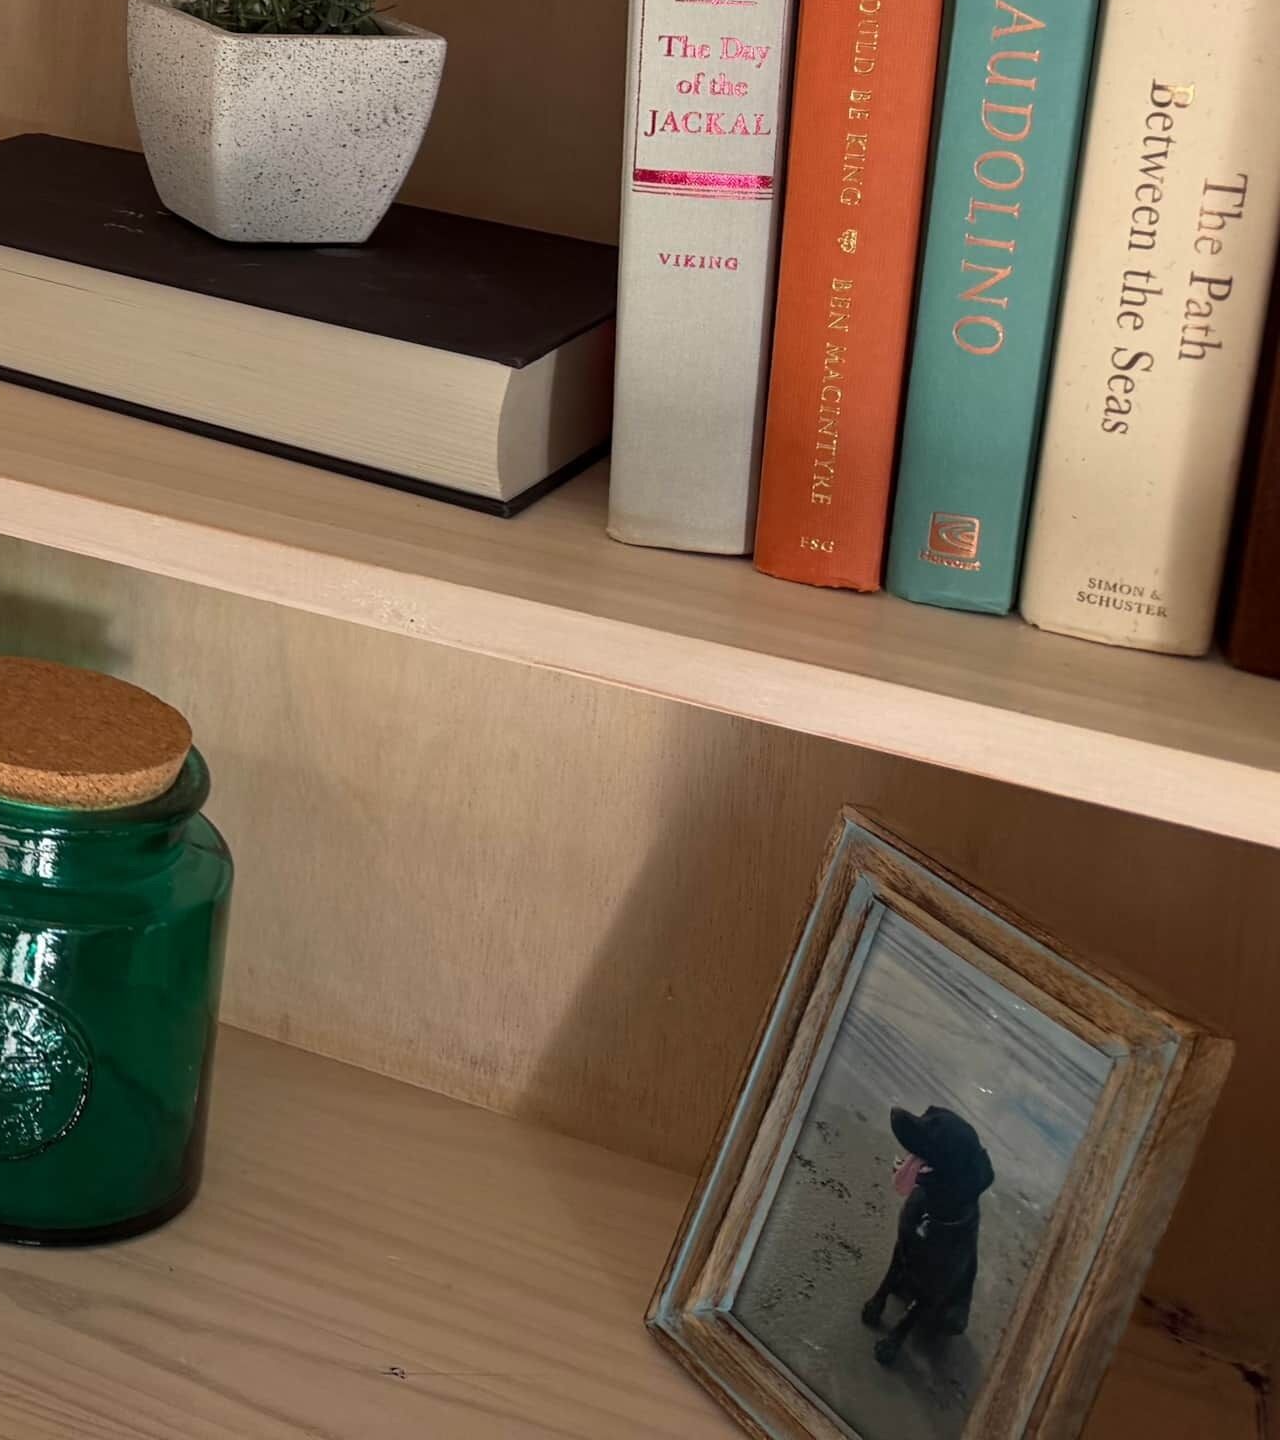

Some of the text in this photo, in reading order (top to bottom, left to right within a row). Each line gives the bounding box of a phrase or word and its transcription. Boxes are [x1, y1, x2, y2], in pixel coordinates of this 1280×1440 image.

[658, 35, 771, 68] The Day
[676, 72, 749, 97] of the
[848, 89, 871, 120] BE
[644, 110, 772, 137] JACKAL
[839, 132, 868, 207] KING
[658, 252, 740, 271] VIKING
[1101, 78, 1196, 435] Between the Seas
[1178, 172, 1248, 361] The Path
[825, 277, 854, 334] BEN
[810, 341, 847, 505] MACINTYRE
[799, 535, 835, 553] FSG
[1087, 576, 1163, 601] SIMON &
[1075, 590, 1169, 619] SCHUSTER
